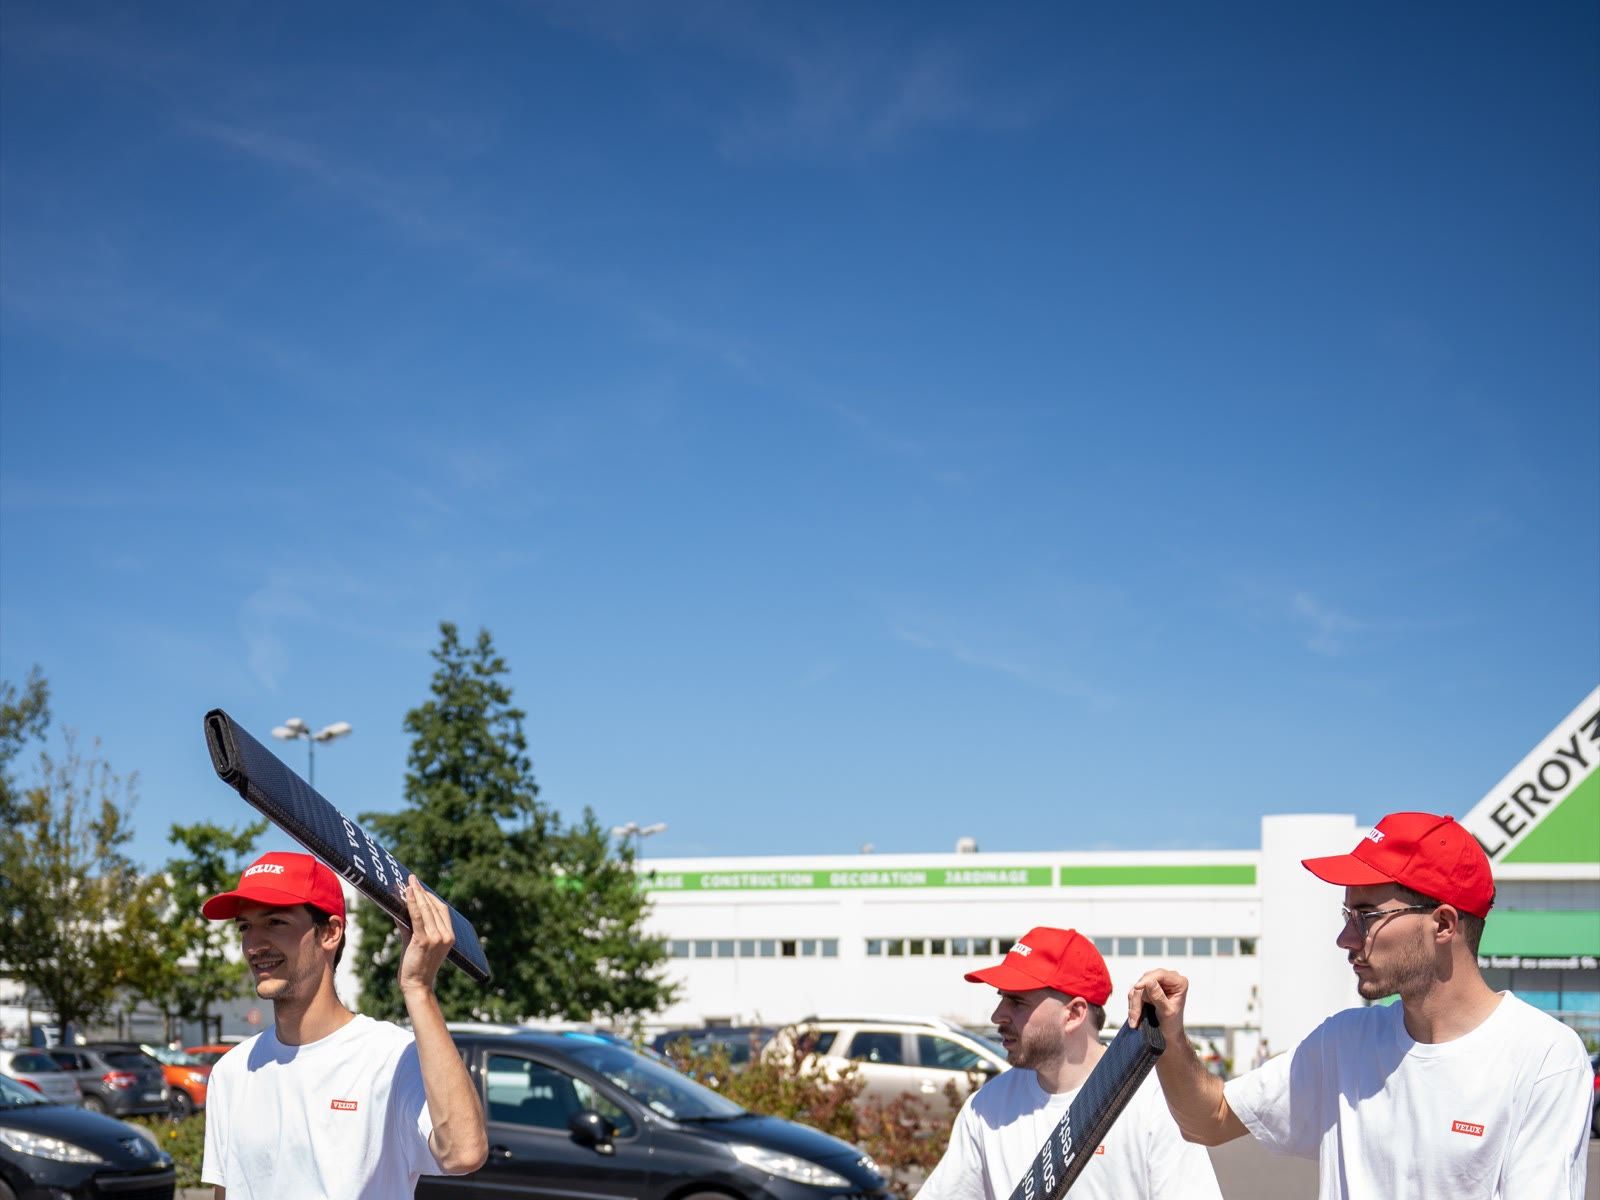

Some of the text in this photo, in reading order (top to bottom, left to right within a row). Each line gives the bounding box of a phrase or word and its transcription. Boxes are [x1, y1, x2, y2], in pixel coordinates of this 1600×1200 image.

[1472, 733, 1589, 858] LEROY
[245, 863, 284, 878] VELUX
[700, 872, 814, 888] CONSTRUCTION
[830, 871, 927, 887] DECORATION
[944, 869, 1029, 885] JARDINAGE
[332, 1100, 356, 1110] VELUX
[1455, 1121, 1483, 1135] VELUX
[1042, 1140, 1056, 1194] sous
